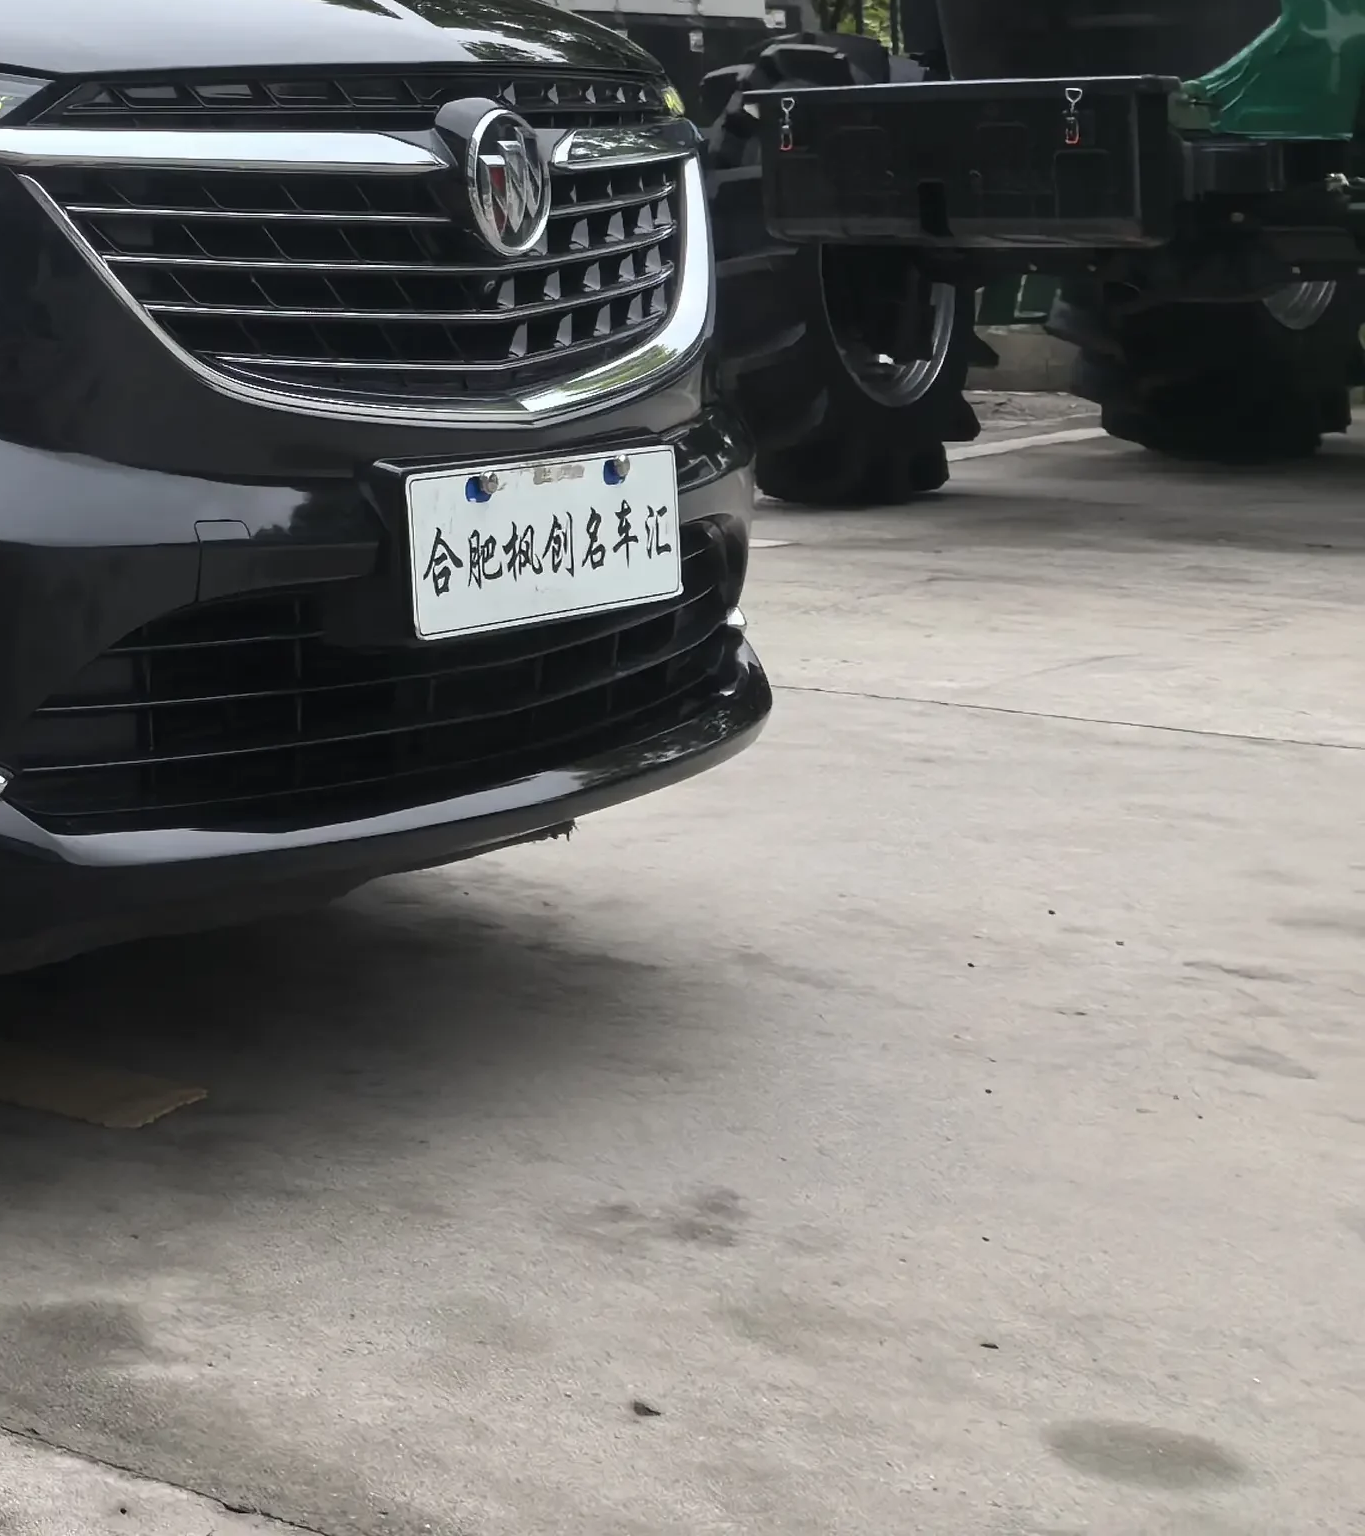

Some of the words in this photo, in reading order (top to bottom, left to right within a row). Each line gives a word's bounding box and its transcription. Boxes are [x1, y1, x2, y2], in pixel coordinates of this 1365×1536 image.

[423, 499, 671, 597] 合肥枫创名车汇
